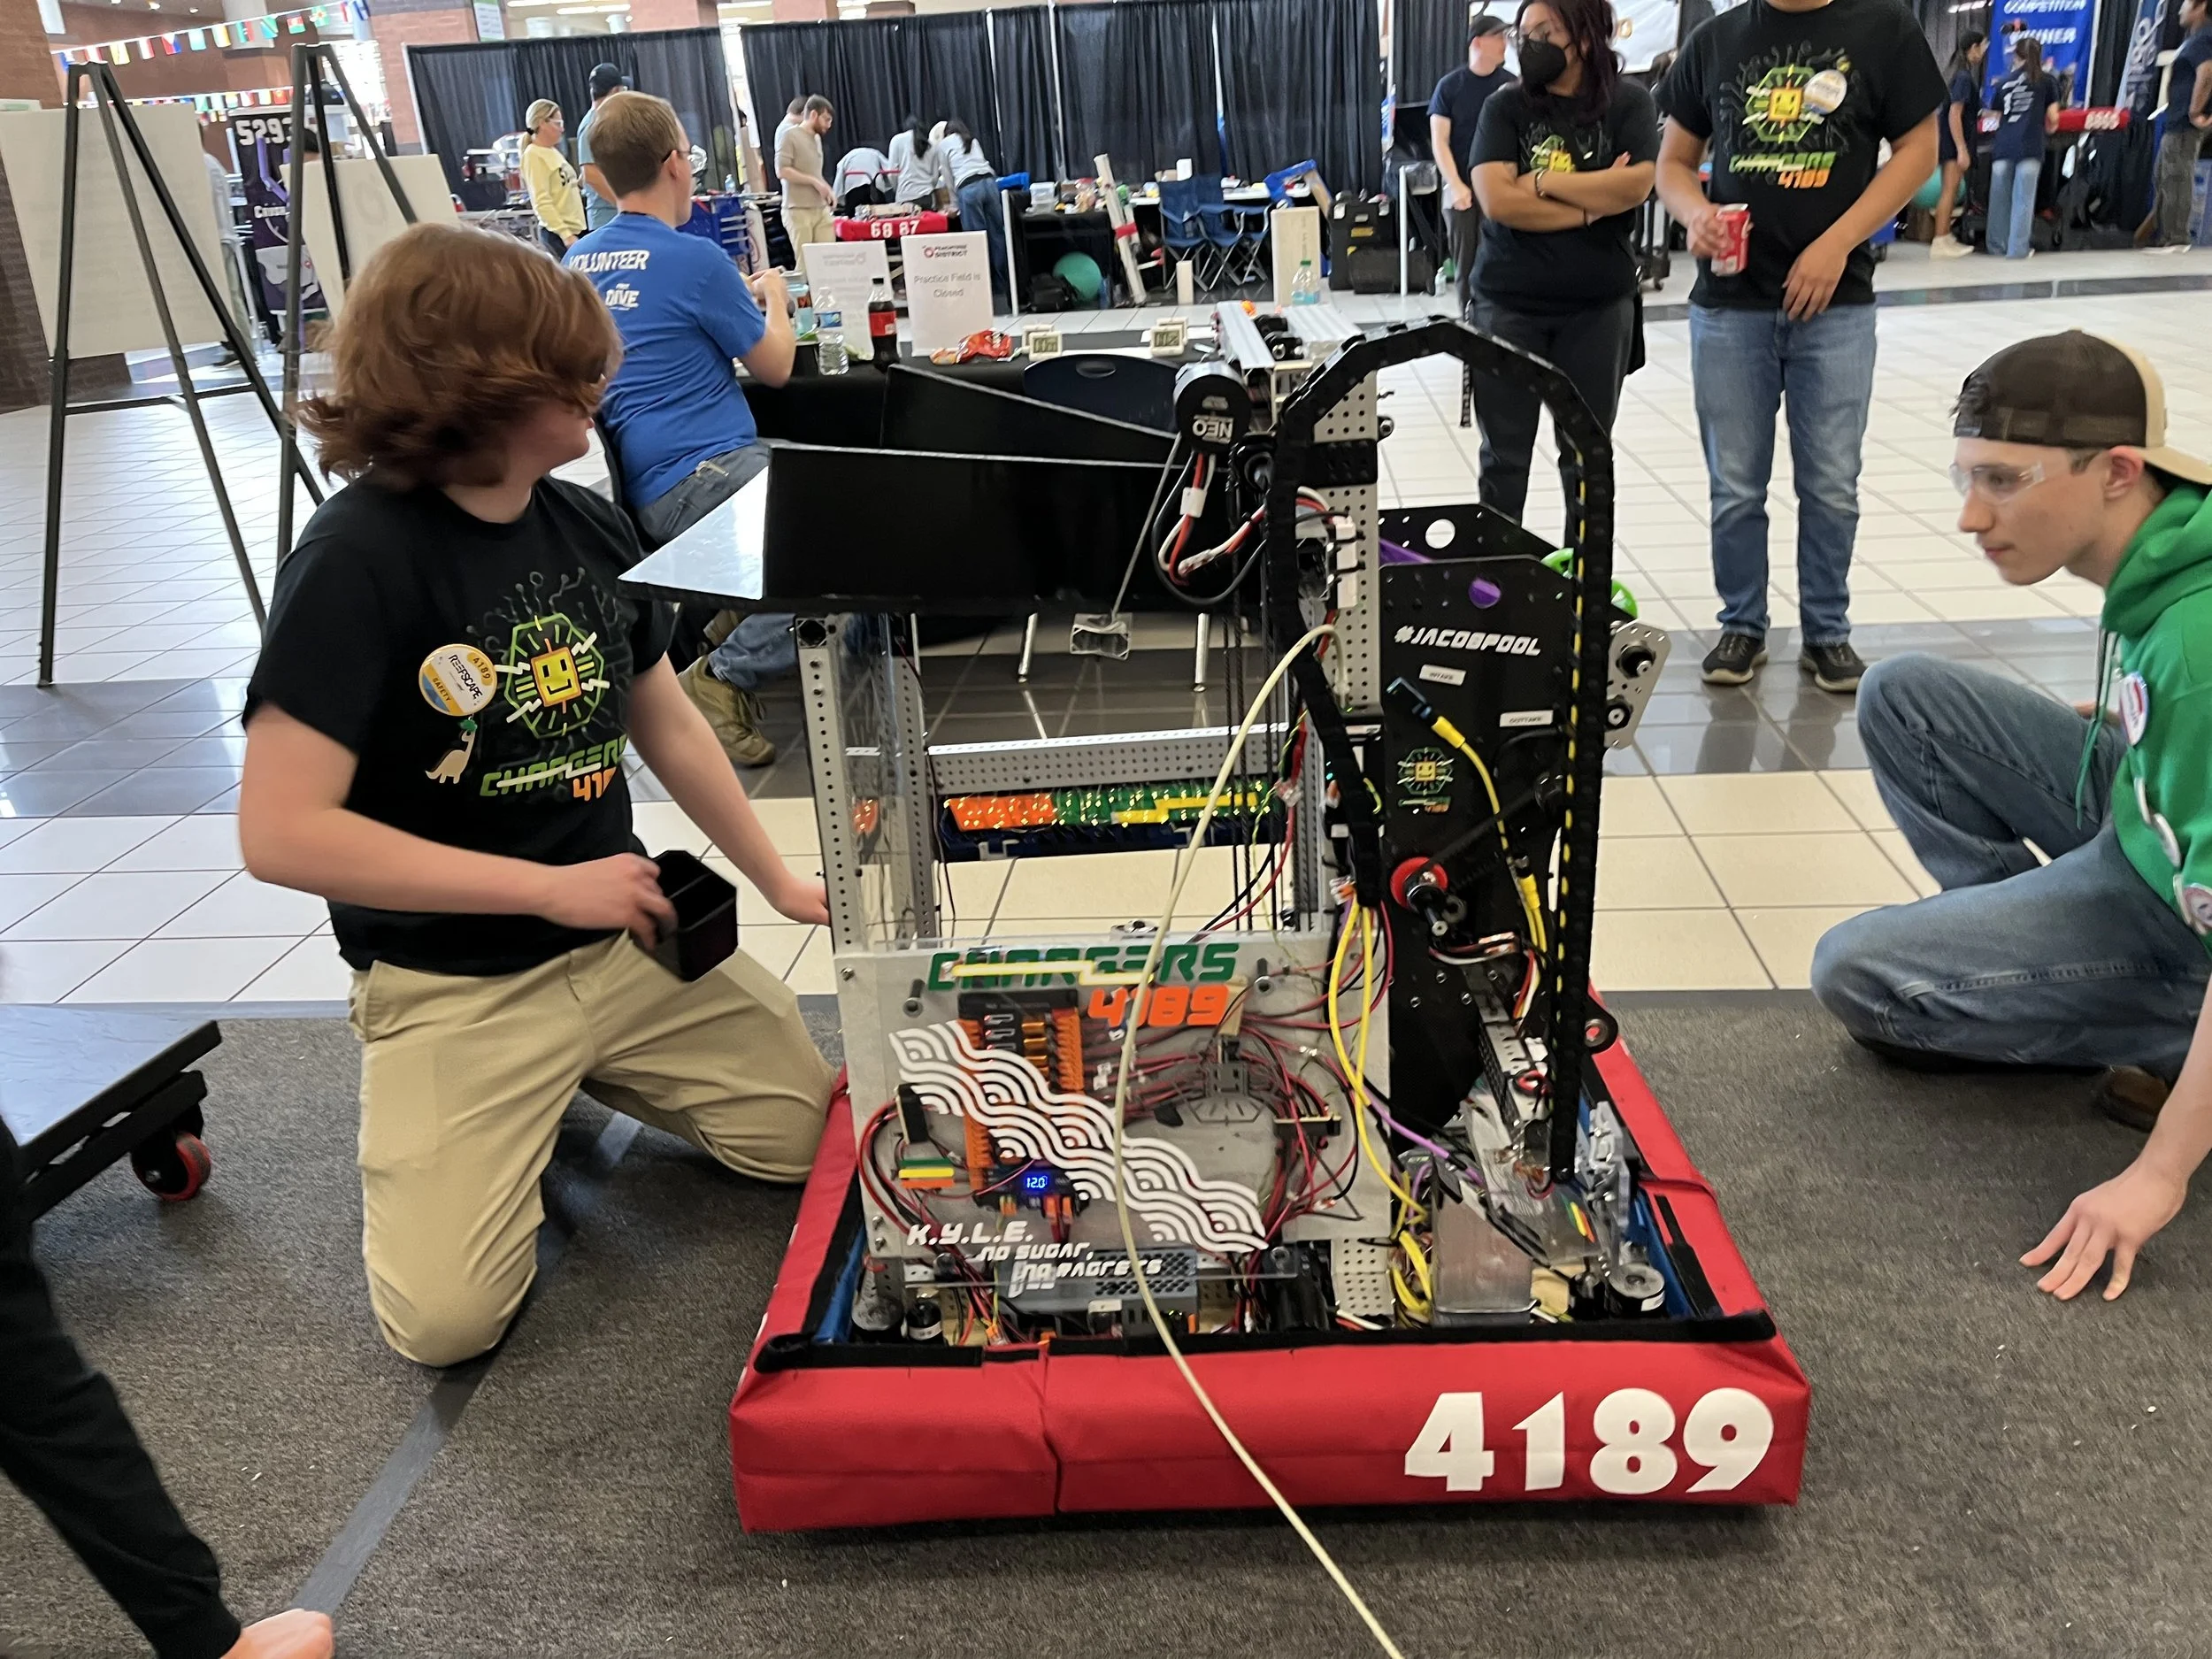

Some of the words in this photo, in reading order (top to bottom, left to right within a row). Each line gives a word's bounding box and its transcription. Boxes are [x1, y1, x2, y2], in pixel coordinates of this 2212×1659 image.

[569, 250, 650, 273] VOLUNTEER
[914, 274, 949, 283] Practice
[950, 273, 972, 281] Field
[933, 288, 964, 298] Closed
[1192, 418, 1233, 441] NEO
[1394, 625, 1541, 657] #JACOBPOOL
[448, 654, 483, 699] REEFSCAPE
[473, 657, 491, 679] 4189
[433, 677, 451, 702] SAFETY
[1087, 984, 1229, 1027] 4189
[1405, 1387, 1774, 1494] 4189
